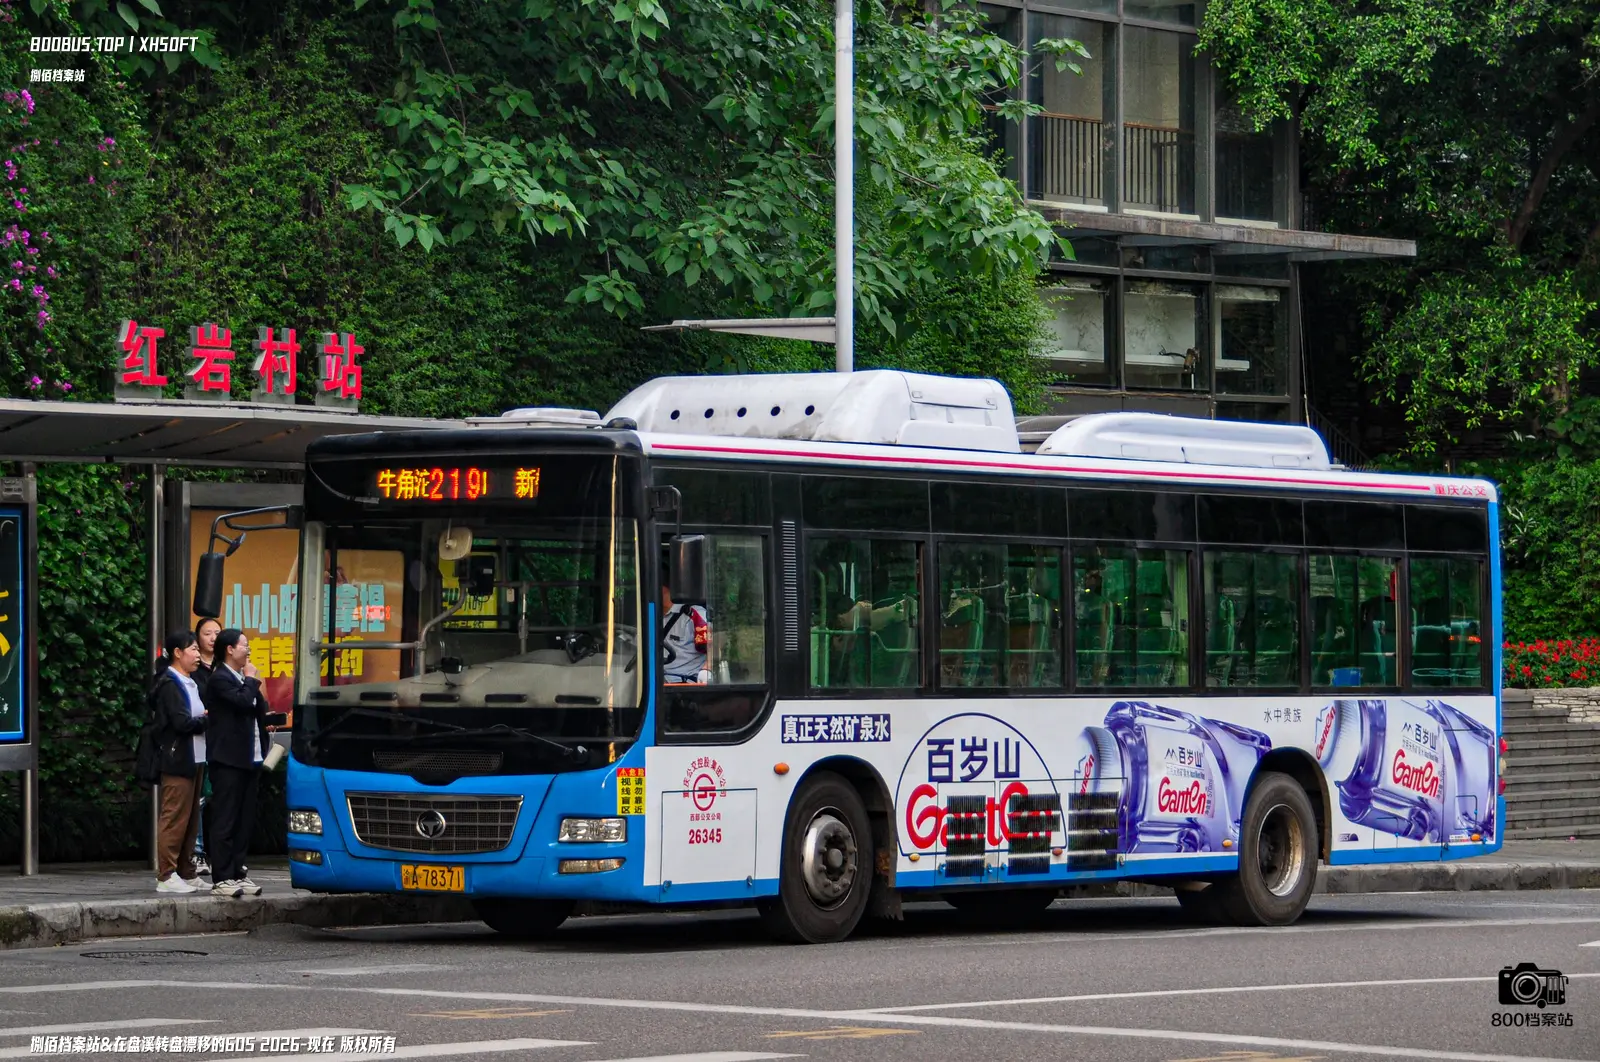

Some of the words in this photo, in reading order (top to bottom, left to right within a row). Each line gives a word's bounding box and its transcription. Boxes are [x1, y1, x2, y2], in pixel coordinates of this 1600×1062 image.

[120, 320, 365, 399] 红岩村站
[1433, 483, 1487, 497] 重庆公交
[1263, 707, 1302, 723] 水中贵族
[783, 716, 889, 742] 真正天然矿泉水
[1415, 724, 1437, 750] 百岁山
[927, 736, 1021, 782] 百岁山
[1178, 746, 1203, 767] 百岁山
[690, 813, 721, 821] 西部公交公司
[688, 828, 722, 844] 26345
